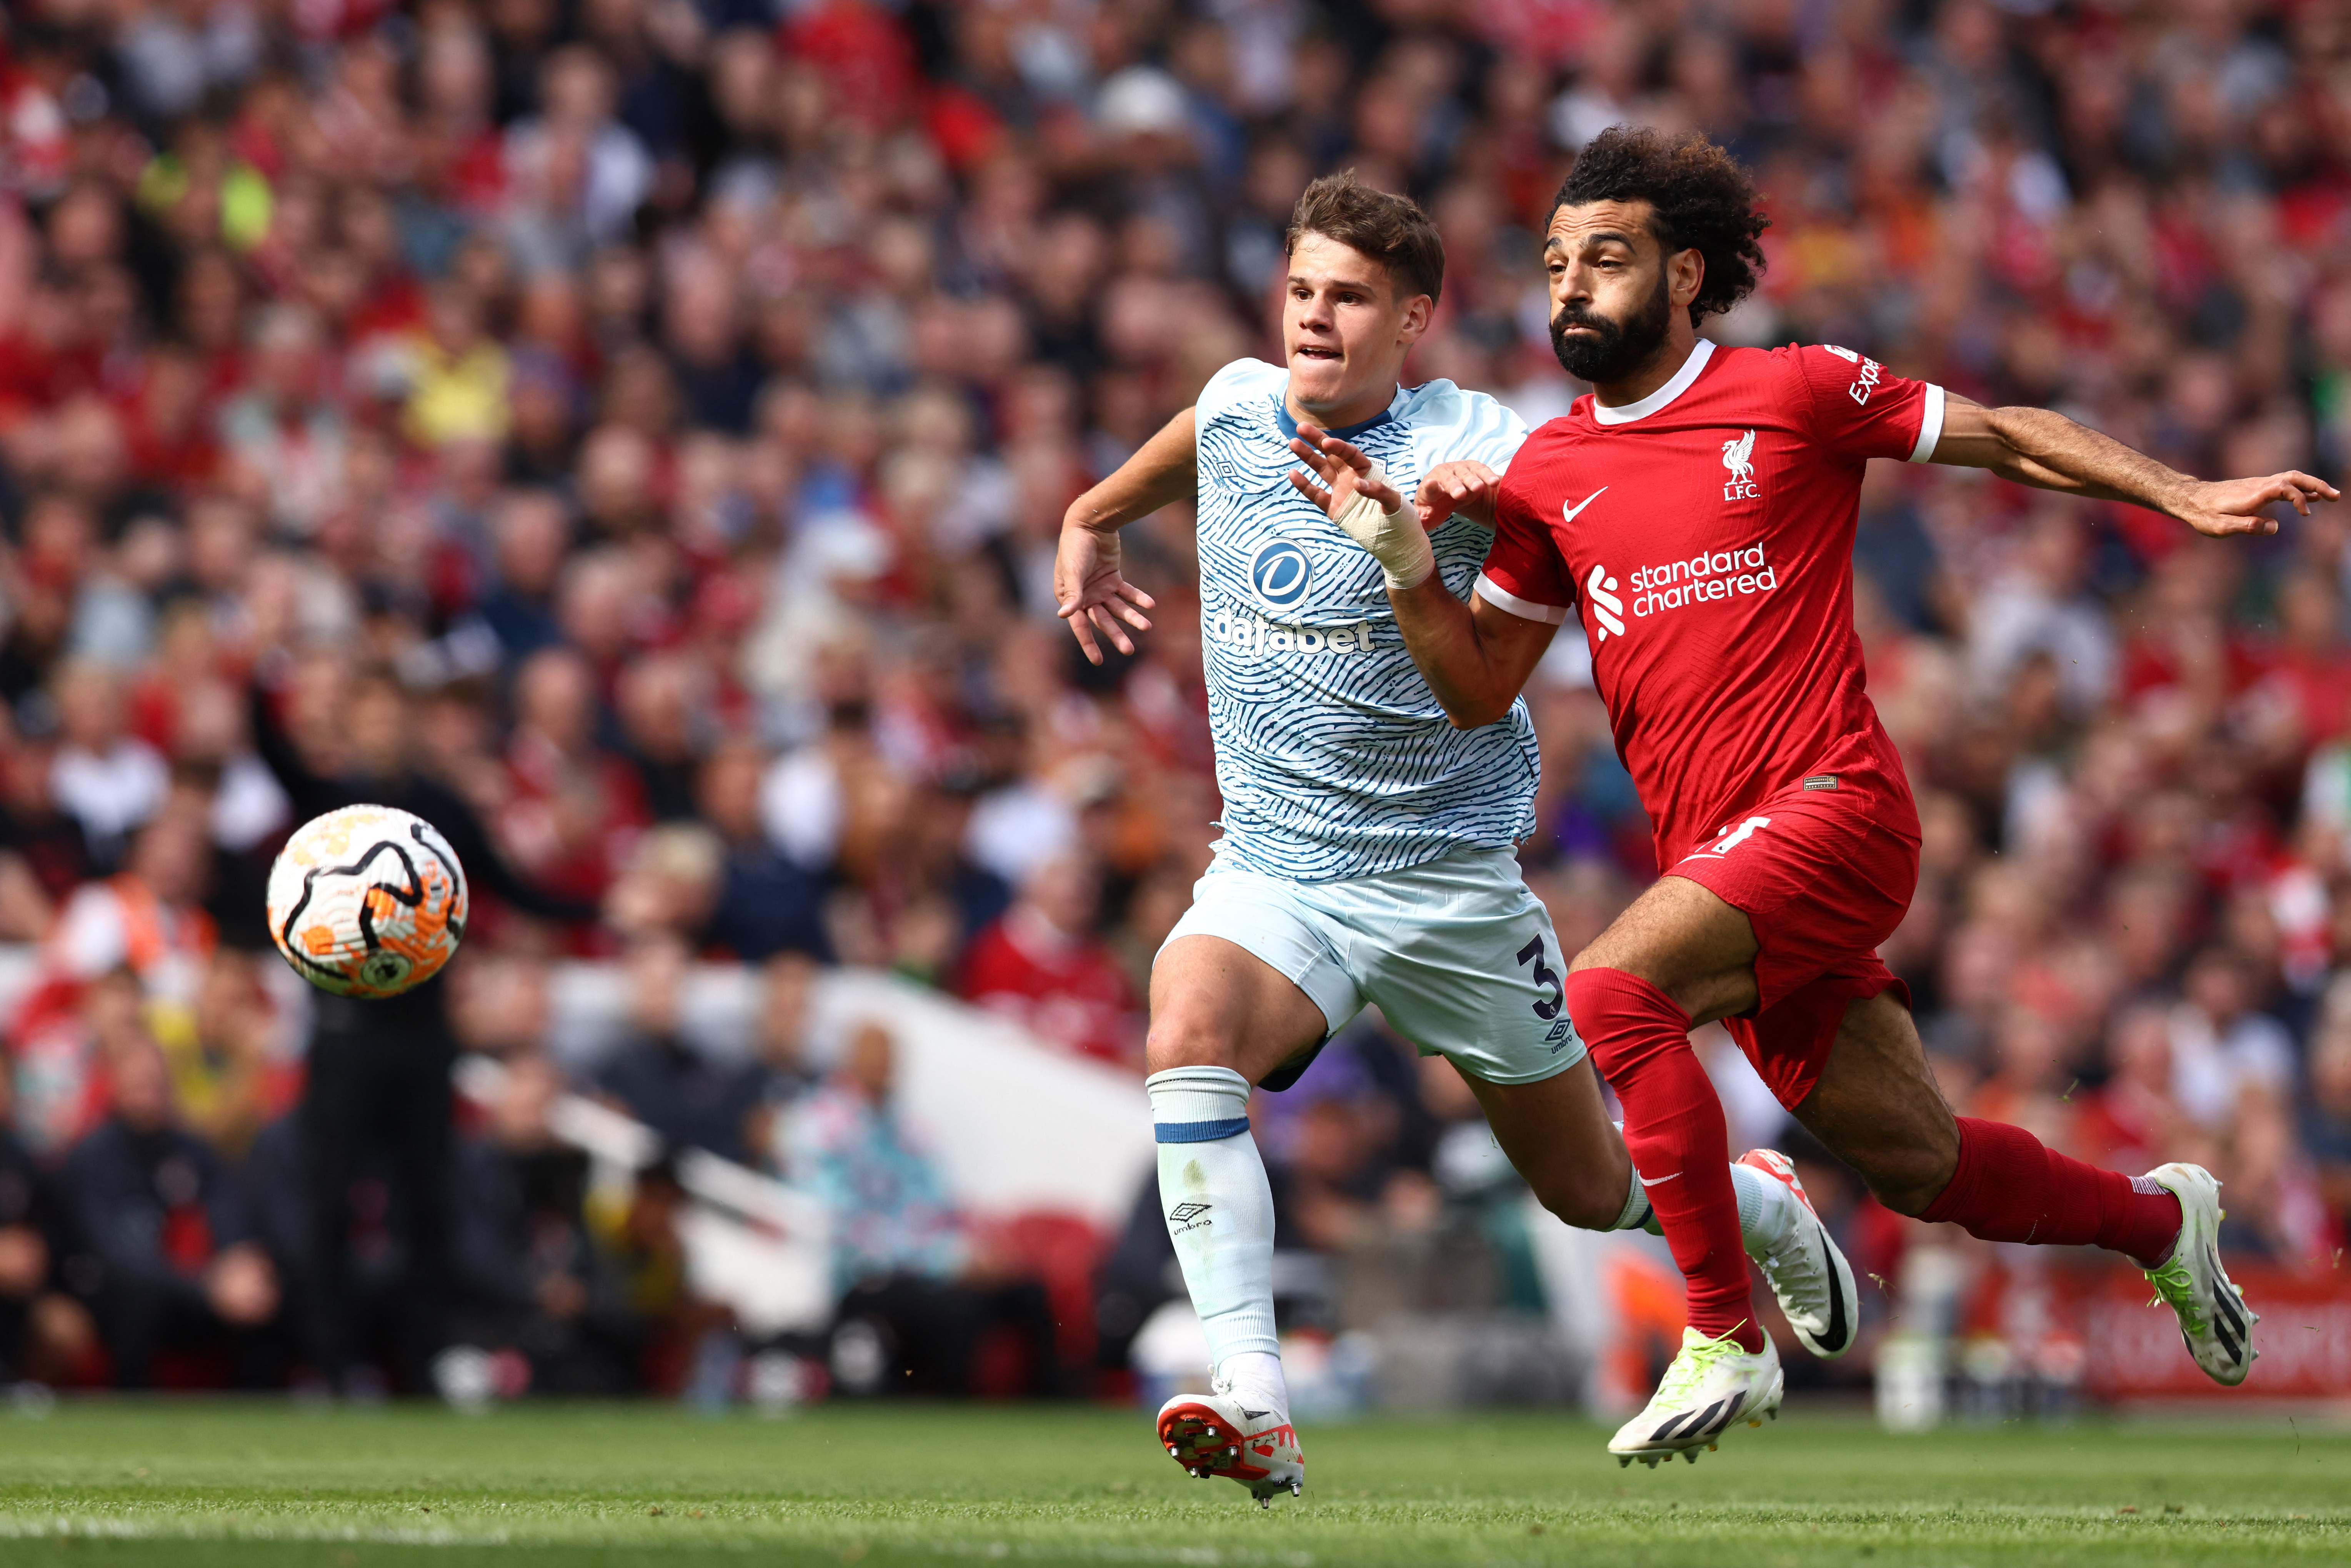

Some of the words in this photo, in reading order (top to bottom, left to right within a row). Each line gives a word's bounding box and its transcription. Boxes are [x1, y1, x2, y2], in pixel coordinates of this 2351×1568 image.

[1630, 542, 1764, 592] standard
[1633, 566, 1777, 617] chartered
[1214, 604, 1376, 657] dafabet
[1516, 932, 1563, 1021] 3
[1551, 1034, 1573, 1055] umbro
[1174, 1220, 1212, 1235] umbro
